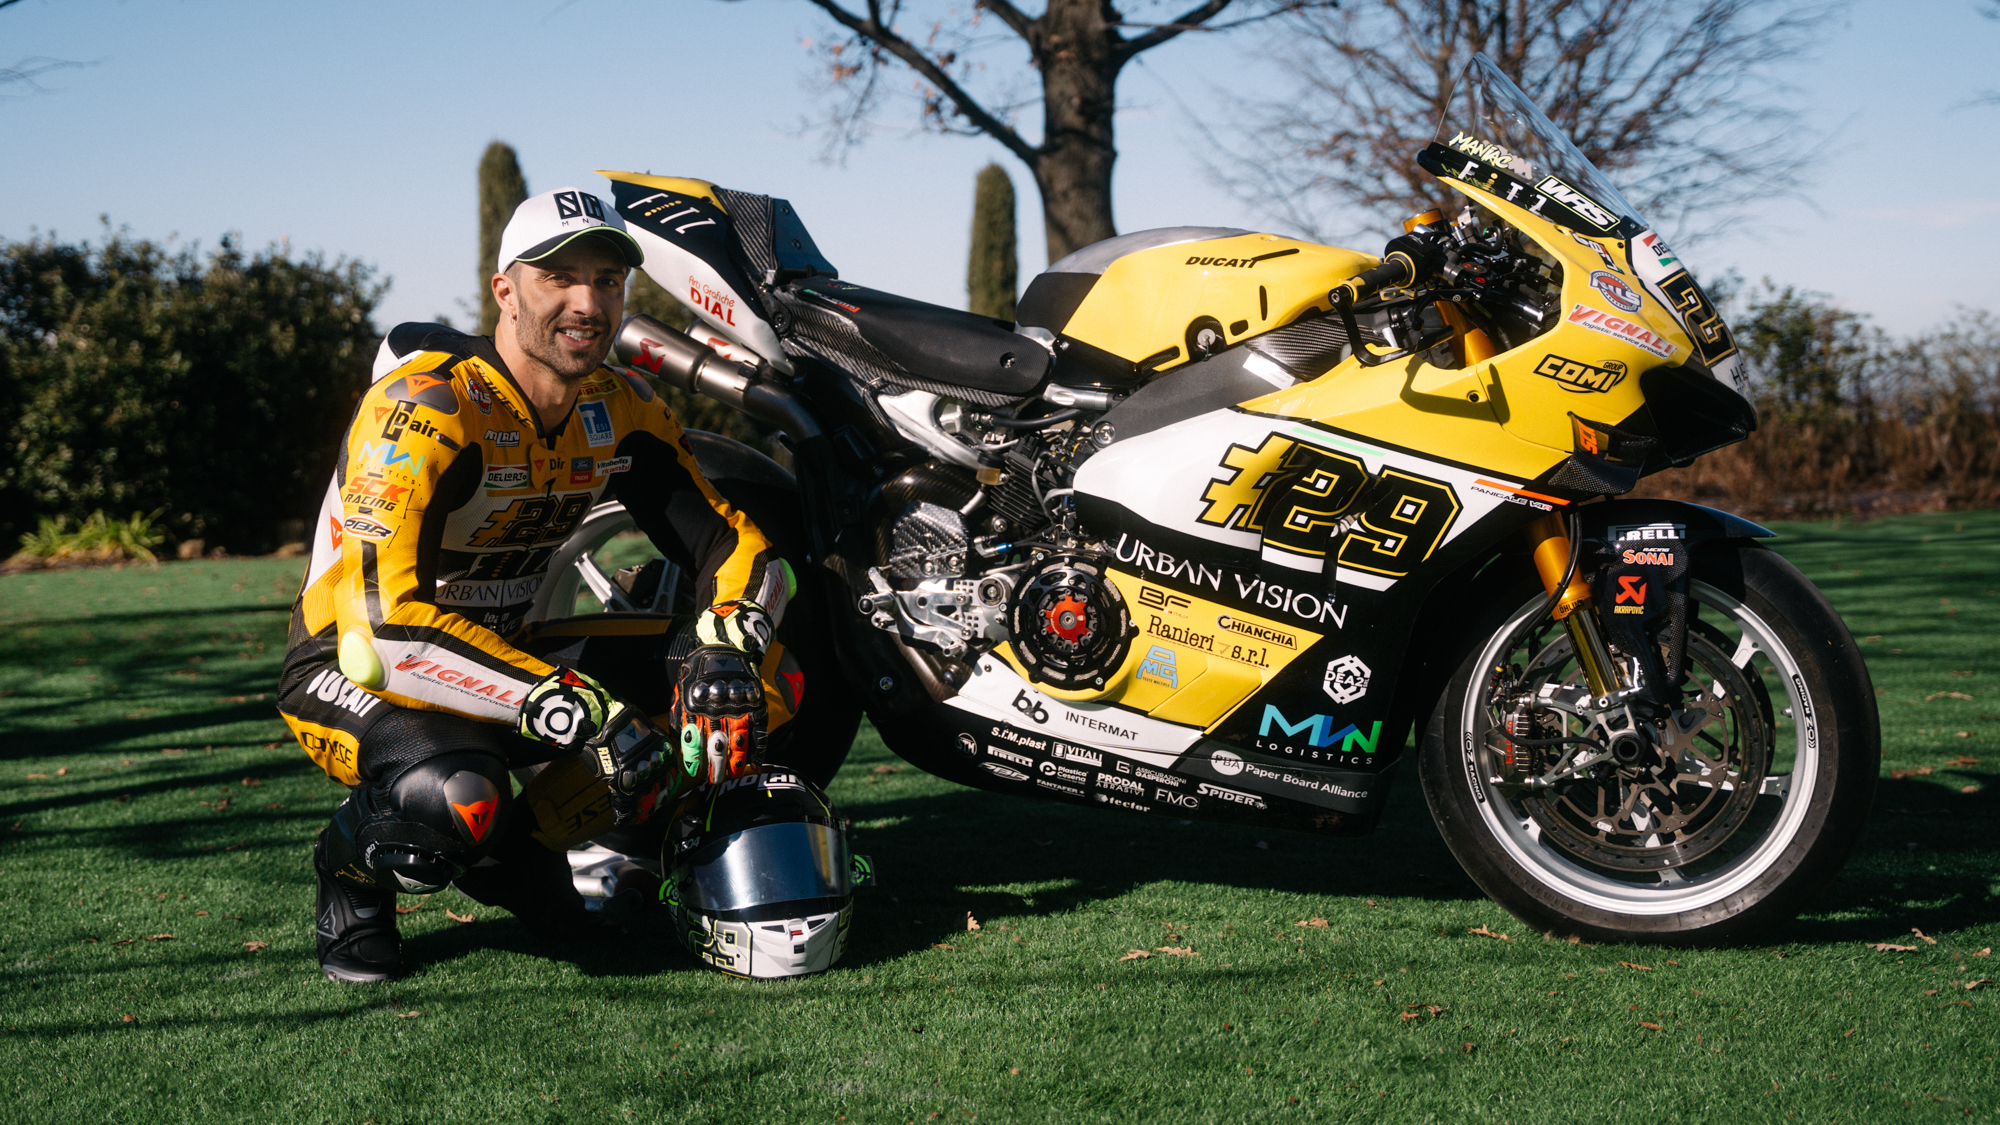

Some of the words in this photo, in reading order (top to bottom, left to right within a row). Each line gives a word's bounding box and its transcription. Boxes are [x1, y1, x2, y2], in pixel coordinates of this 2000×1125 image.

[1538, 177, 1617, 226] WRS
[1185, 256, 1259, 269] DUCATI
[690, 286, 736, 327] DIAL
[702, 284, 736, 308] Grafiche
[1567, 304, 1674, 354] VIGNALI
[1582, 320, 1612, 336] logistic
[1612, 330, 1640, 343] service
[1639, 342, 1669, 360] provider
[1535, 355, 1620, 393] COMI
[1602, 361, 1624, 371] GROUP
[355, 463, 416, 485] LOGISTICS
[347, 476, 410, 503] SCK
[1470, 486, 1529, 506] PANIGALE
[344, 493, 398, 512] RACING
[1194, 430, 1465, 578] #29
[1622, 549, 1674, 566] SONAI
[1115, 532, 1223, 592] URBAN
[1234, 573, 1349, 630] VISION
[1146, 614, 1215, 652] Ranieri
[1231, 645, 1270, 668] s.r.l.
[1216, 614, 1294, 648] CHIANCHIA
[409, 670, 444, 687] logistic
[444, 683, 477, 698] service
[1795, 677, 1811, 714] RACING
[1065, 710, 1139, 742] INTERMAT
[986, 744, 1034, 768] PIRELLI
[1066, 745, 1103, 763] VITALI
[1214, 753, 1242, 770] PBA
[1256, 740, 1373, 765] LOGISTICS
[1057, 765, 1087, 777] Plastica
[1057, 771, 1087, 782] Cesena
[1097, 772, 1145, 792] PRODAL
[1135, 766, 1187, 784] ASSICURAZIONI
[1135, 770, 1180, 787] GASPERONI
[1245, 763, 1281, 780] Paper
[1282, 773, 1319, 790] Board
[1320, 783, 1368, 799] Alliance
[1469, 764, 1483, 800] RACING
[717, 772, 807, 797] NOLAN
[1095, 781, 1145, 797] ABRASIVI
[1196, 783, 1264, 807] SPIDER
[1109, 796, 1151, 813] tector
